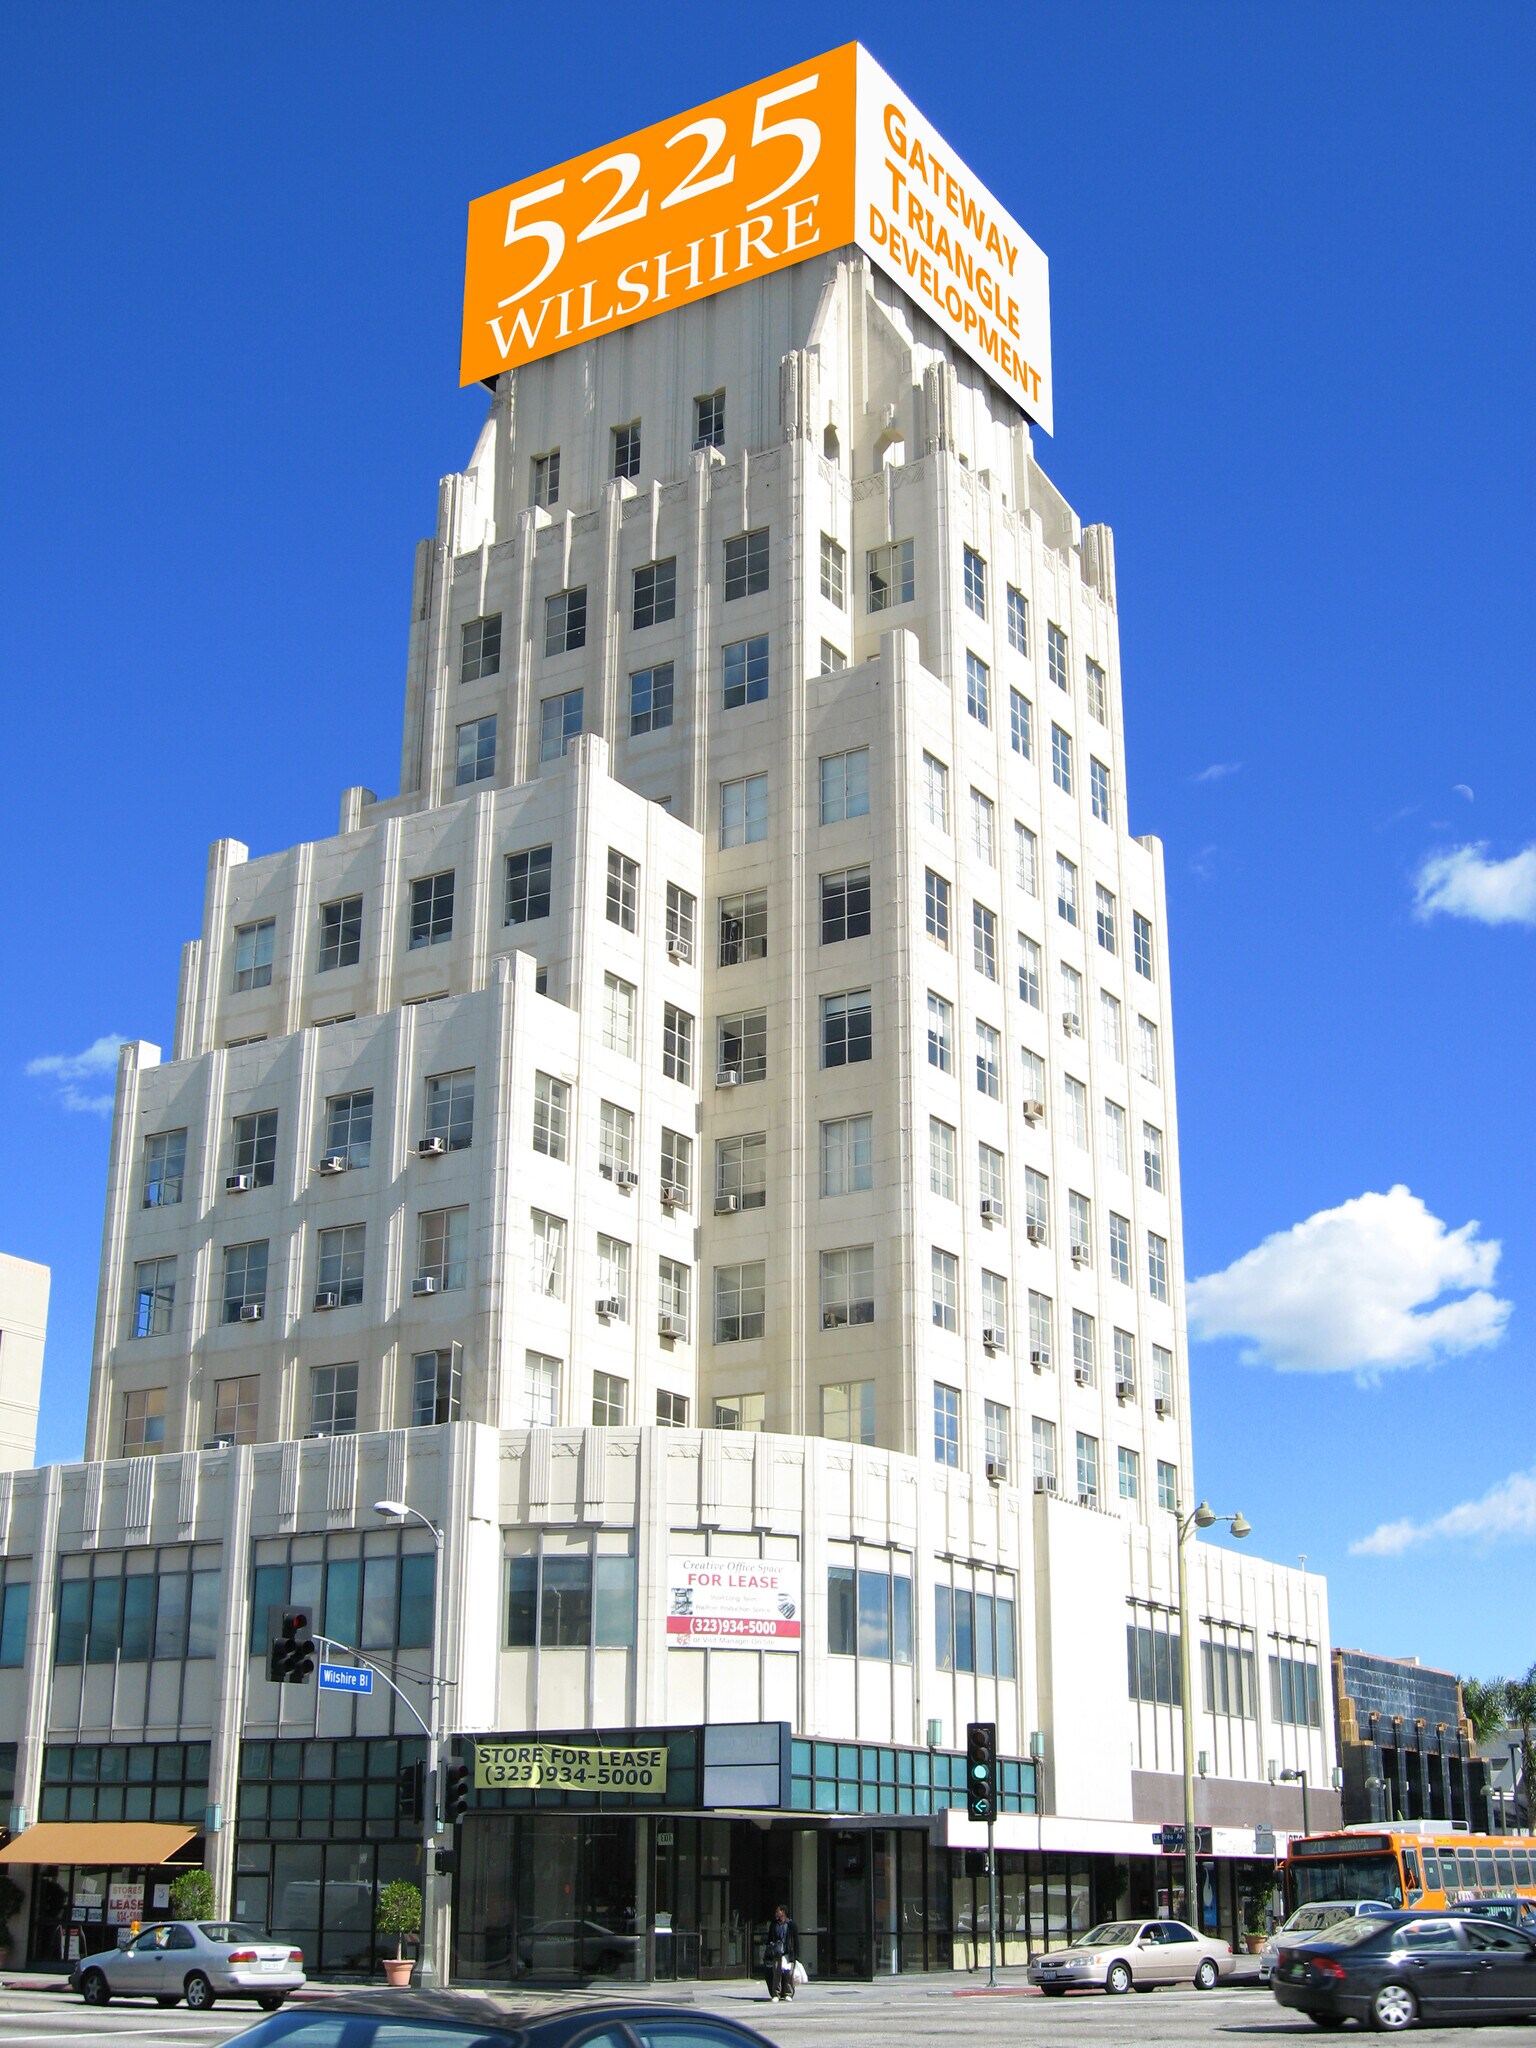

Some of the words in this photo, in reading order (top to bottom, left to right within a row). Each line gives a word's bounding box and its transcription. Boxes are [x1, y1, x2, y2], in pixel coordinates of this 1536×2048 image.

[496, 72, 823, 310] 5225
[883, 102, 1020, 277] GATEWAY
[885, 156, 1022, 341] TRIANGLE
[486, 193, 822, 360] WILSHIRE
[870, 202, 1042, 404] DEVELOPMENT
[683, 1560, 725, 1571] Creative
[727, 1562, 755, 1574] Office
[758, 1563, 784, 1575] Space
[687, 1573, 722, 1587] FOR
[729, 1575, 778, 1589] LEASE
[689, 1618, 777, 1636] (323)934-5000
[323, 1669, 357, 1685] Wilshire
[359, 1674, 368, 1687] Bl
[479, 1747, 544, 1764] STORE
[550, 1748, 591, 1766] FOR
[598, 1751, 661, 1768] LEASE
[485, 1764, 653, 1787] (323)934-5000
[1310, 1842, 1326, 1854] 20
[112, 1886, 143, 1895] STORES
[109, 1898, 144, 1910] LEASE
